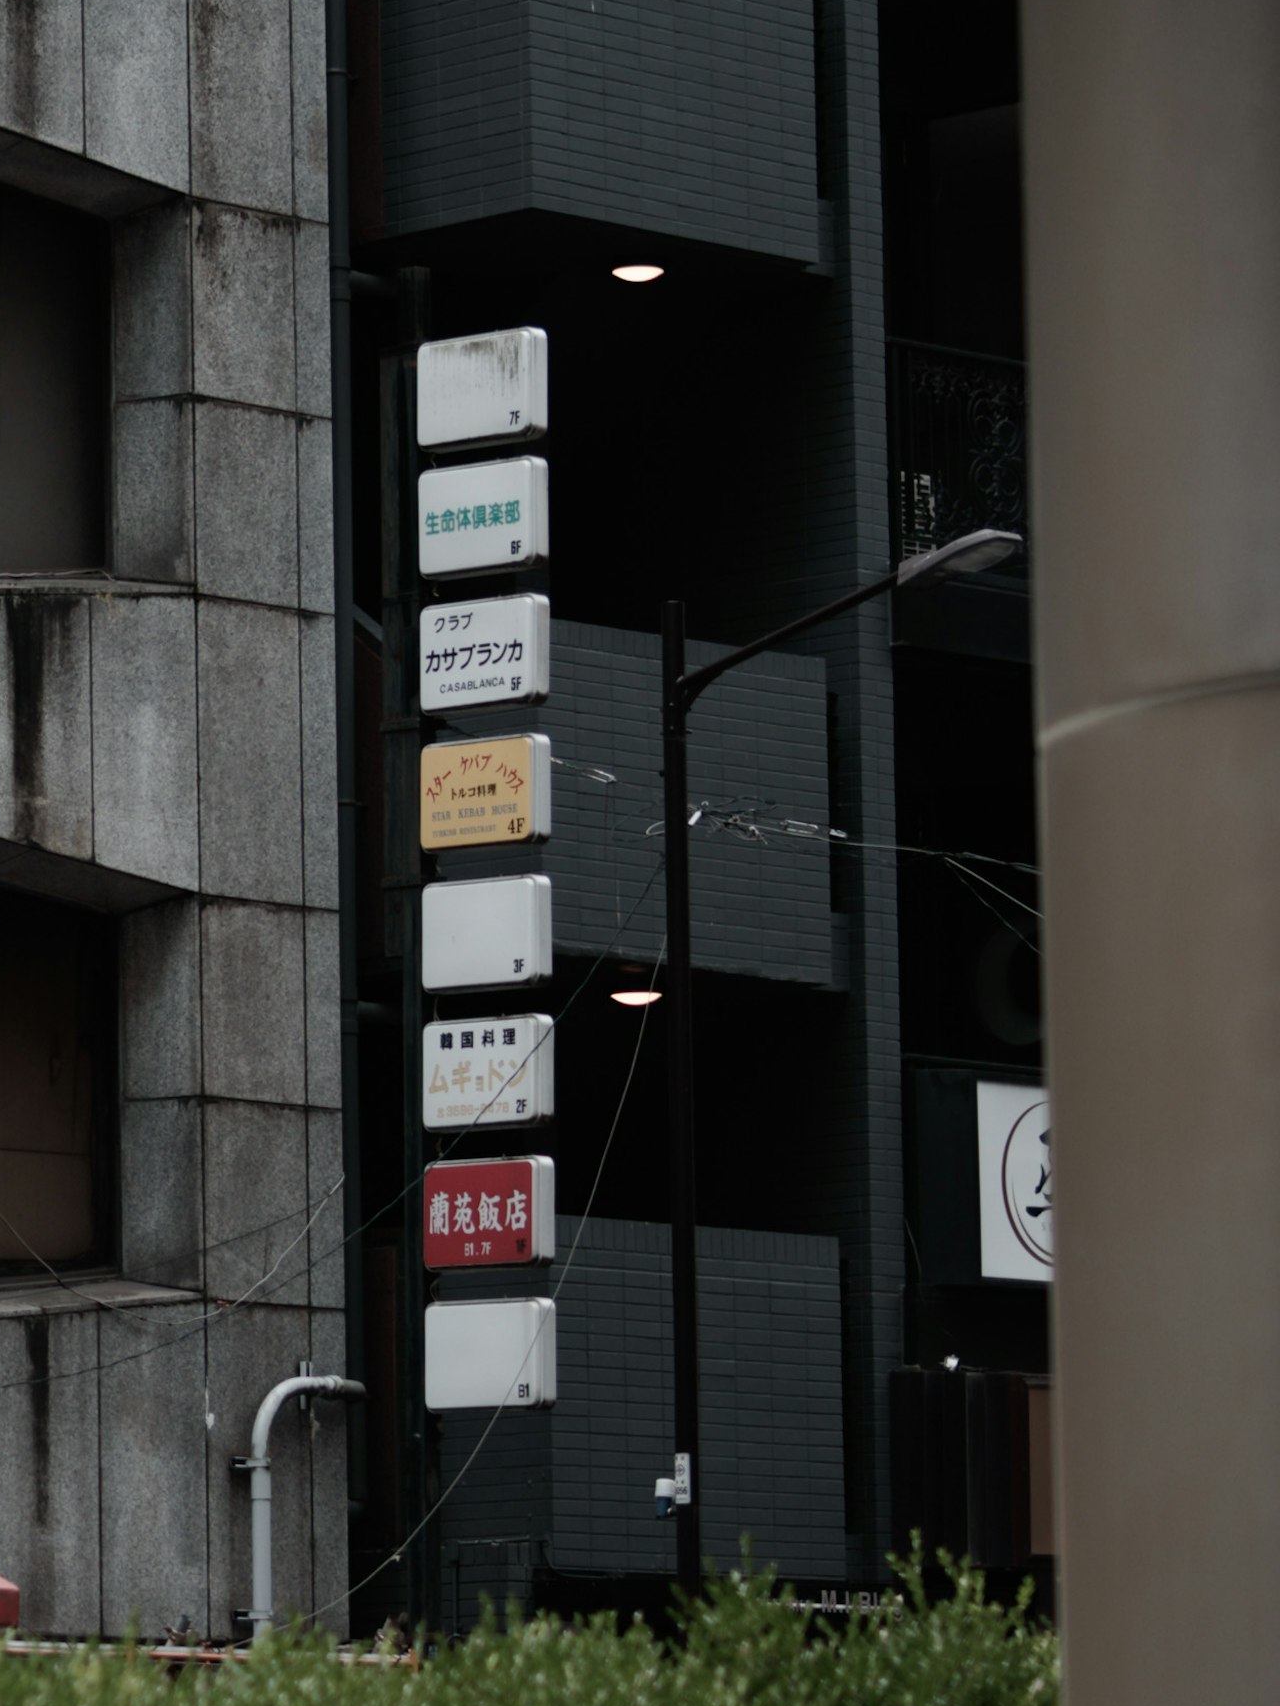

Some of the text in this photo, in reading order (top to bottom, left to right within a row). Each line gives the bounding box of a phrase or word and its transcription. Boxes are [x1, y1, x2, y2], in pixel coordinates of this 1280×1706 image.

[509, 410, 521, 426] 7F
[510, 540, 522, 555] 6F
[434, 612, 473, 634] クラブ
[425, 639, 523, 674] カサブランカ
[439, 677, 505, 694] CASABLANCA
[511, 676, 522, 691] 5F
[451, 783, 497, 801] トルコ料理
[507, 818, 525, 834] 4F
[513, 958, 524, 974] 3F
[440, 1027, 516, 1050] 韓国料理
[428, 1058, 528, 1094] ムギョドン
[516, 1099, 527, 1114] 2F
[429, 1189, 527, 1236] 蘭苑飯店
[518, 1383, 530, 1398] B1
